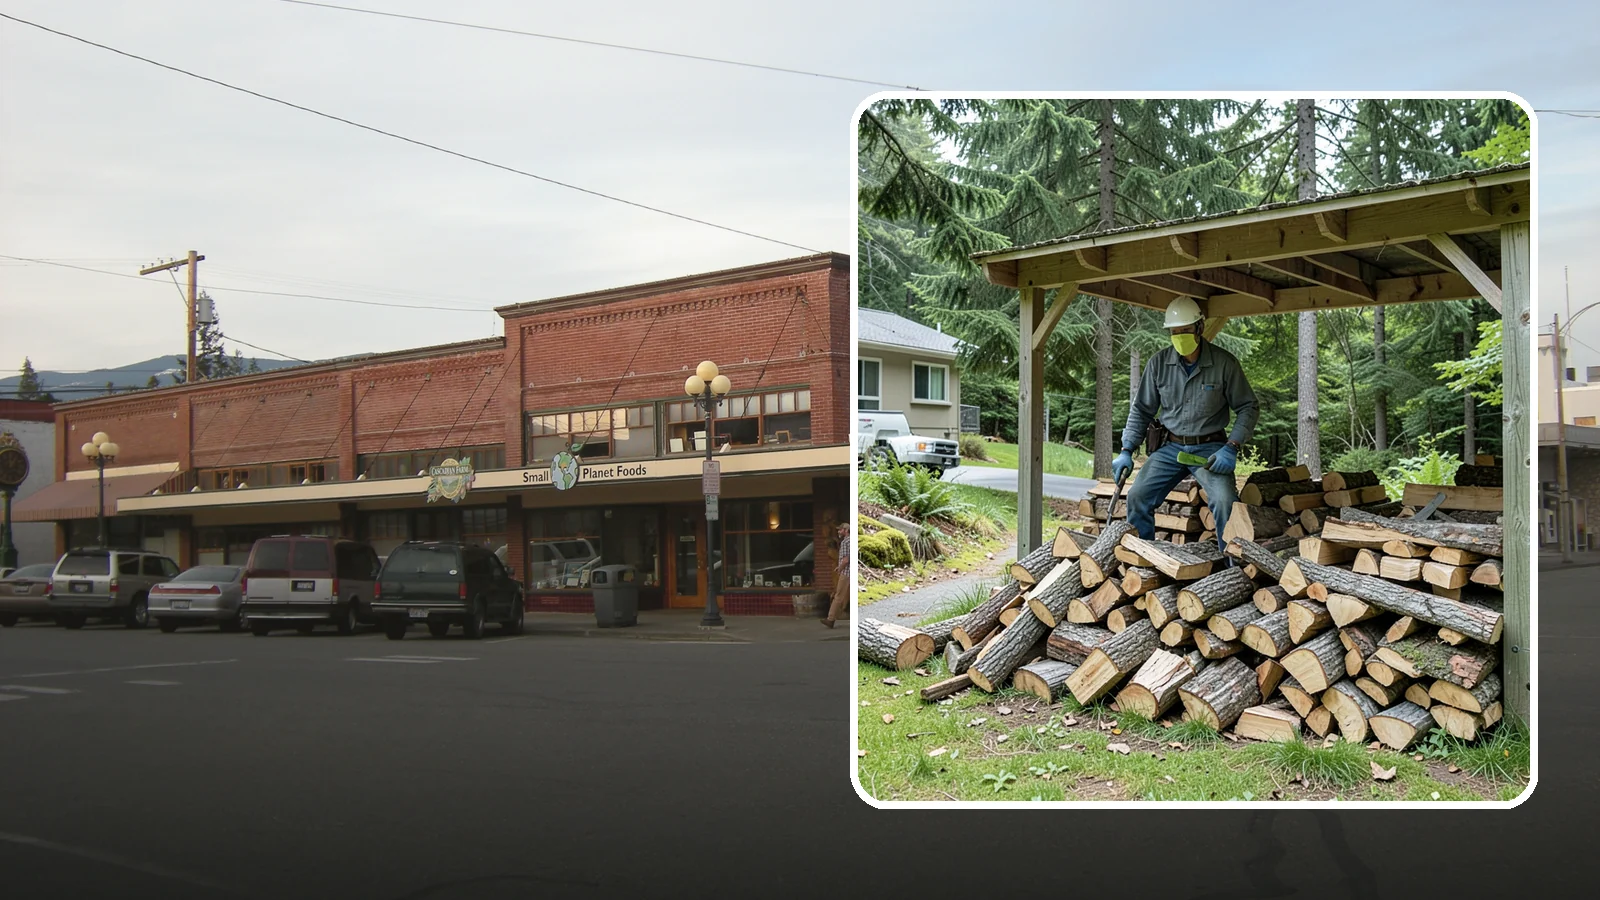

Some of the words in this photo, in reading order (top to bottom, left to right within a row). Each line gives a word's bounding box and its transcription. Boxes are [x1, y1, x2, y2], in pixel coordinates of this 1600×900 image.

[523, 471, 549, 483] Small
[582, 467, 614, 479] Planet
[616, 465, 647, 477] Foods
